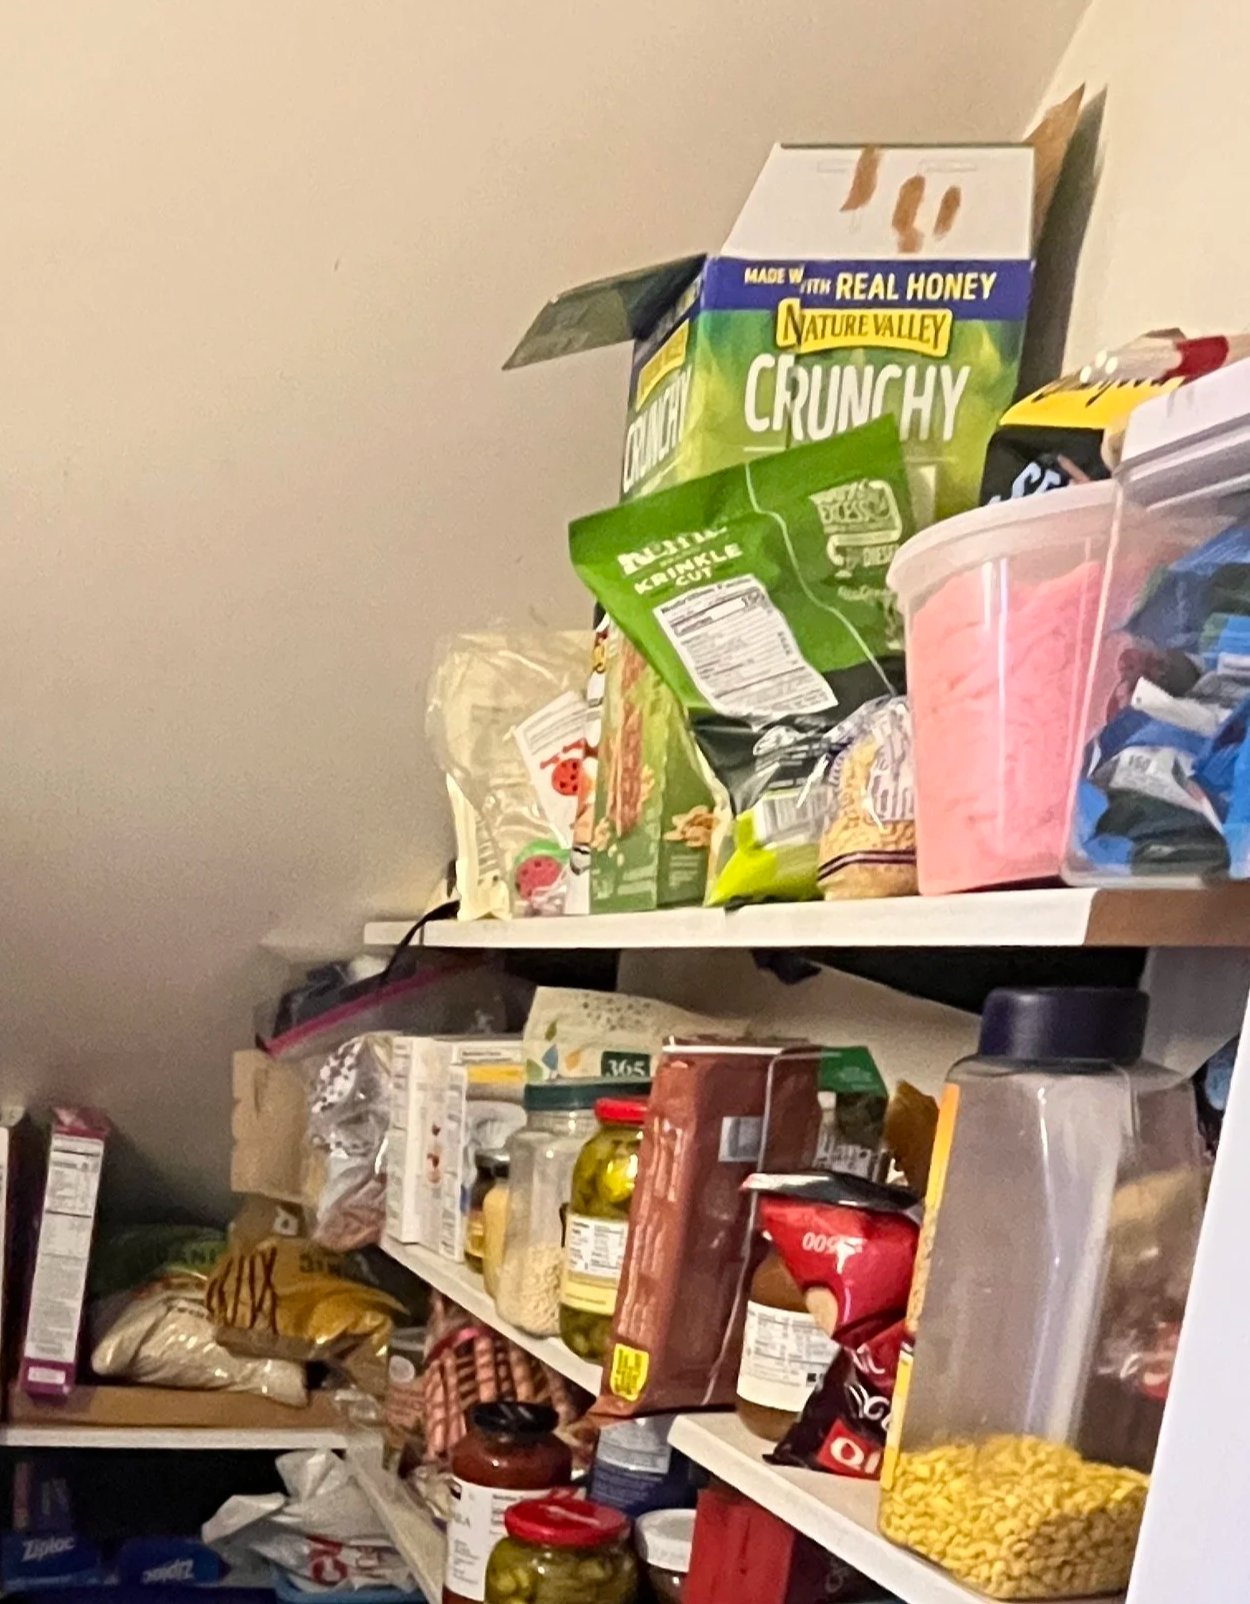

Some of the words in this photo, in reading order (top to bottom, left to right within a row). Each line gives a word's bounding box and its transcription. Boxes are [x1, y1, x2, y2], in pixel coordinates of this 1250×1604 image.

[744, 266, 786, 286] MADE
[788, 264, 831, 295] WITH
[835, 276, 899, 300] REAL
[906, 272, 998, 300] HONEY
[782, 302, 869, 345] NATURE
[872, 311, 948, 345] VALLEY
[744, 353, 972, 442] CRUNCHY
[622, 366, 693, 495] CRUNCHY
[634, 542, 743, 595] KRINKLE
[675, 567, 714, 587] CUT
[605, 1058, 646, 1078] 365
[22, 1536, 75, 1562] Ziploc
